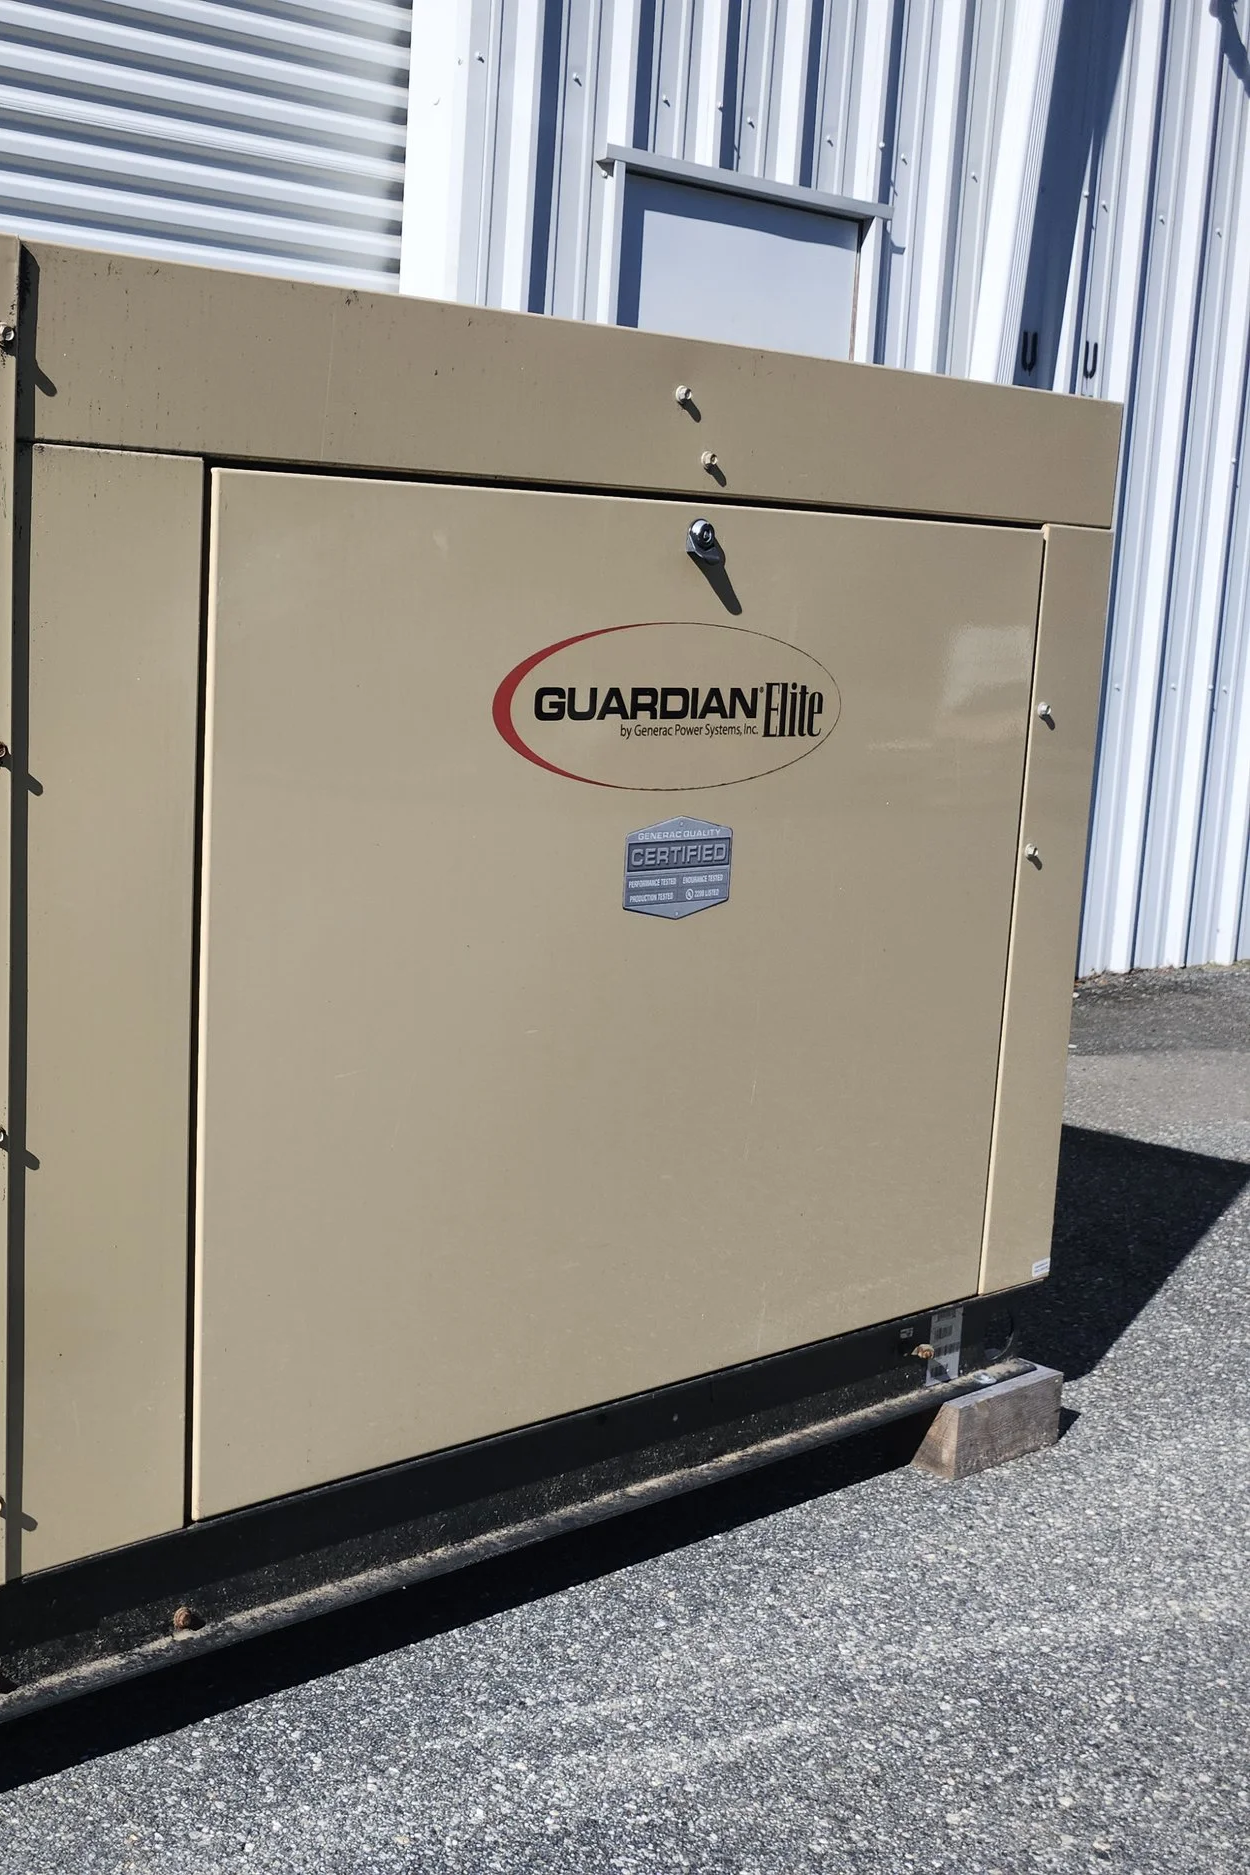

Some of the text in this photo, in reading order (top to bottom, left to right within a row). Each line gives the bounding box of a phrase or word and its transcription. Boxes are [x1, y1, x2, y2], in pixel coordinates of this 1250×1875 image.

[762, 682, 824, 738] Elite
[620, 723, 759, 739] by Generac Power Systems, Inc.
[638, 829, 721, 840] GENERAC QUALITY
[631, 843, 726, 866] CERTIFIED
[628, 877, 677, 888] PERFORMANCE TESTED
[708, 874, 723, 882] TESTED
[629, 892, 674, 903] PRODUCTION TESTED
